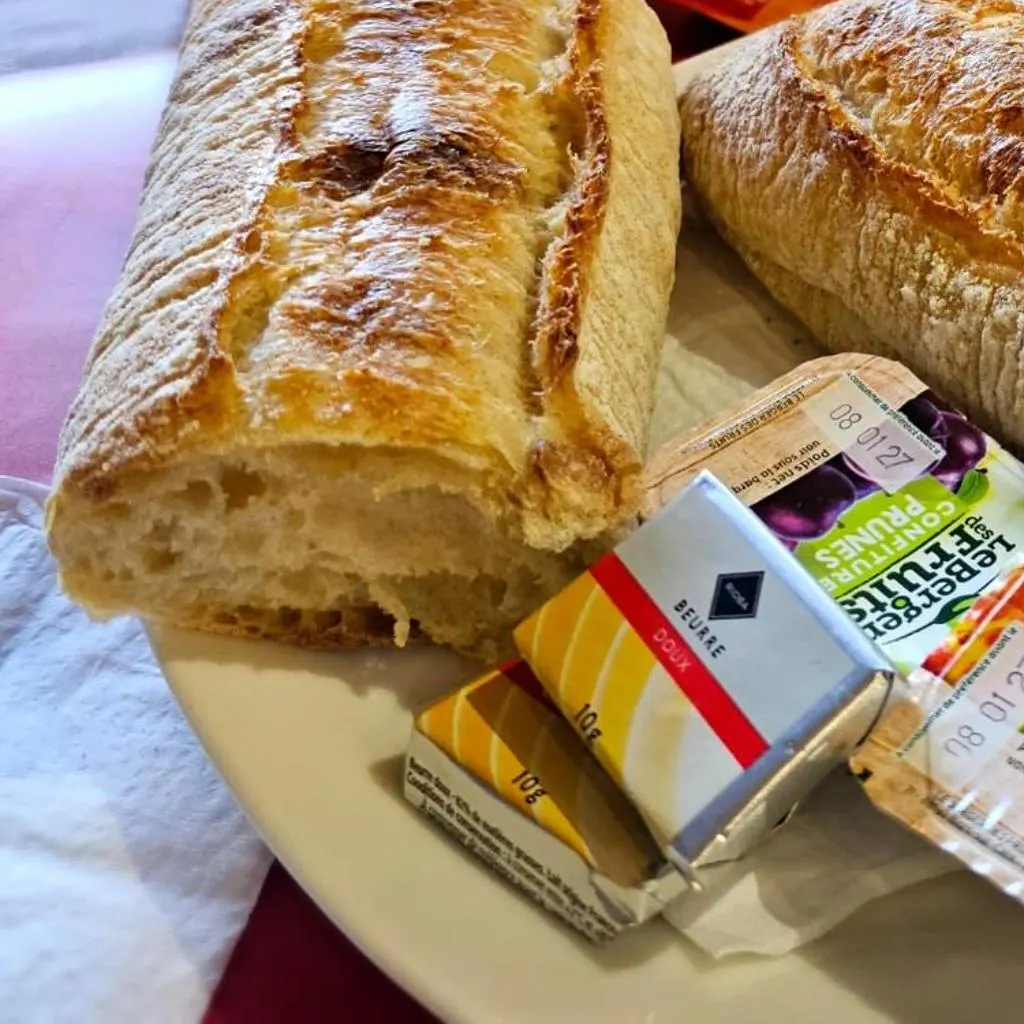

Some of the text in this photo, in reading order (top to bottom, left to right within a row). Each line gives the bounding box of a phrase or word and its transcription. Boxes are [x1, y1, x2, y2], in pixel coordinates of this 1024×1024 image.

[775, 454, 798, 471] sous
[797, 448, 831, 471] Poids
[799, 439, 821, 457] voir
[830, 403, 915, 470] 08 01 27
[774, 468, 795, 487] net
[814, 494, 926, 569] PRUNES
[820, 501, 956, 592] CONFITURE
[840, 516, 995, 624] des Fruits
[652, 627, 692, 673] DOUX
[673, 598, 727, 659] BEURRE
[944, 725, 985, 757] 08
[979, 691, 1016, 722] 01
[512, 770, 547, 805] 10g
